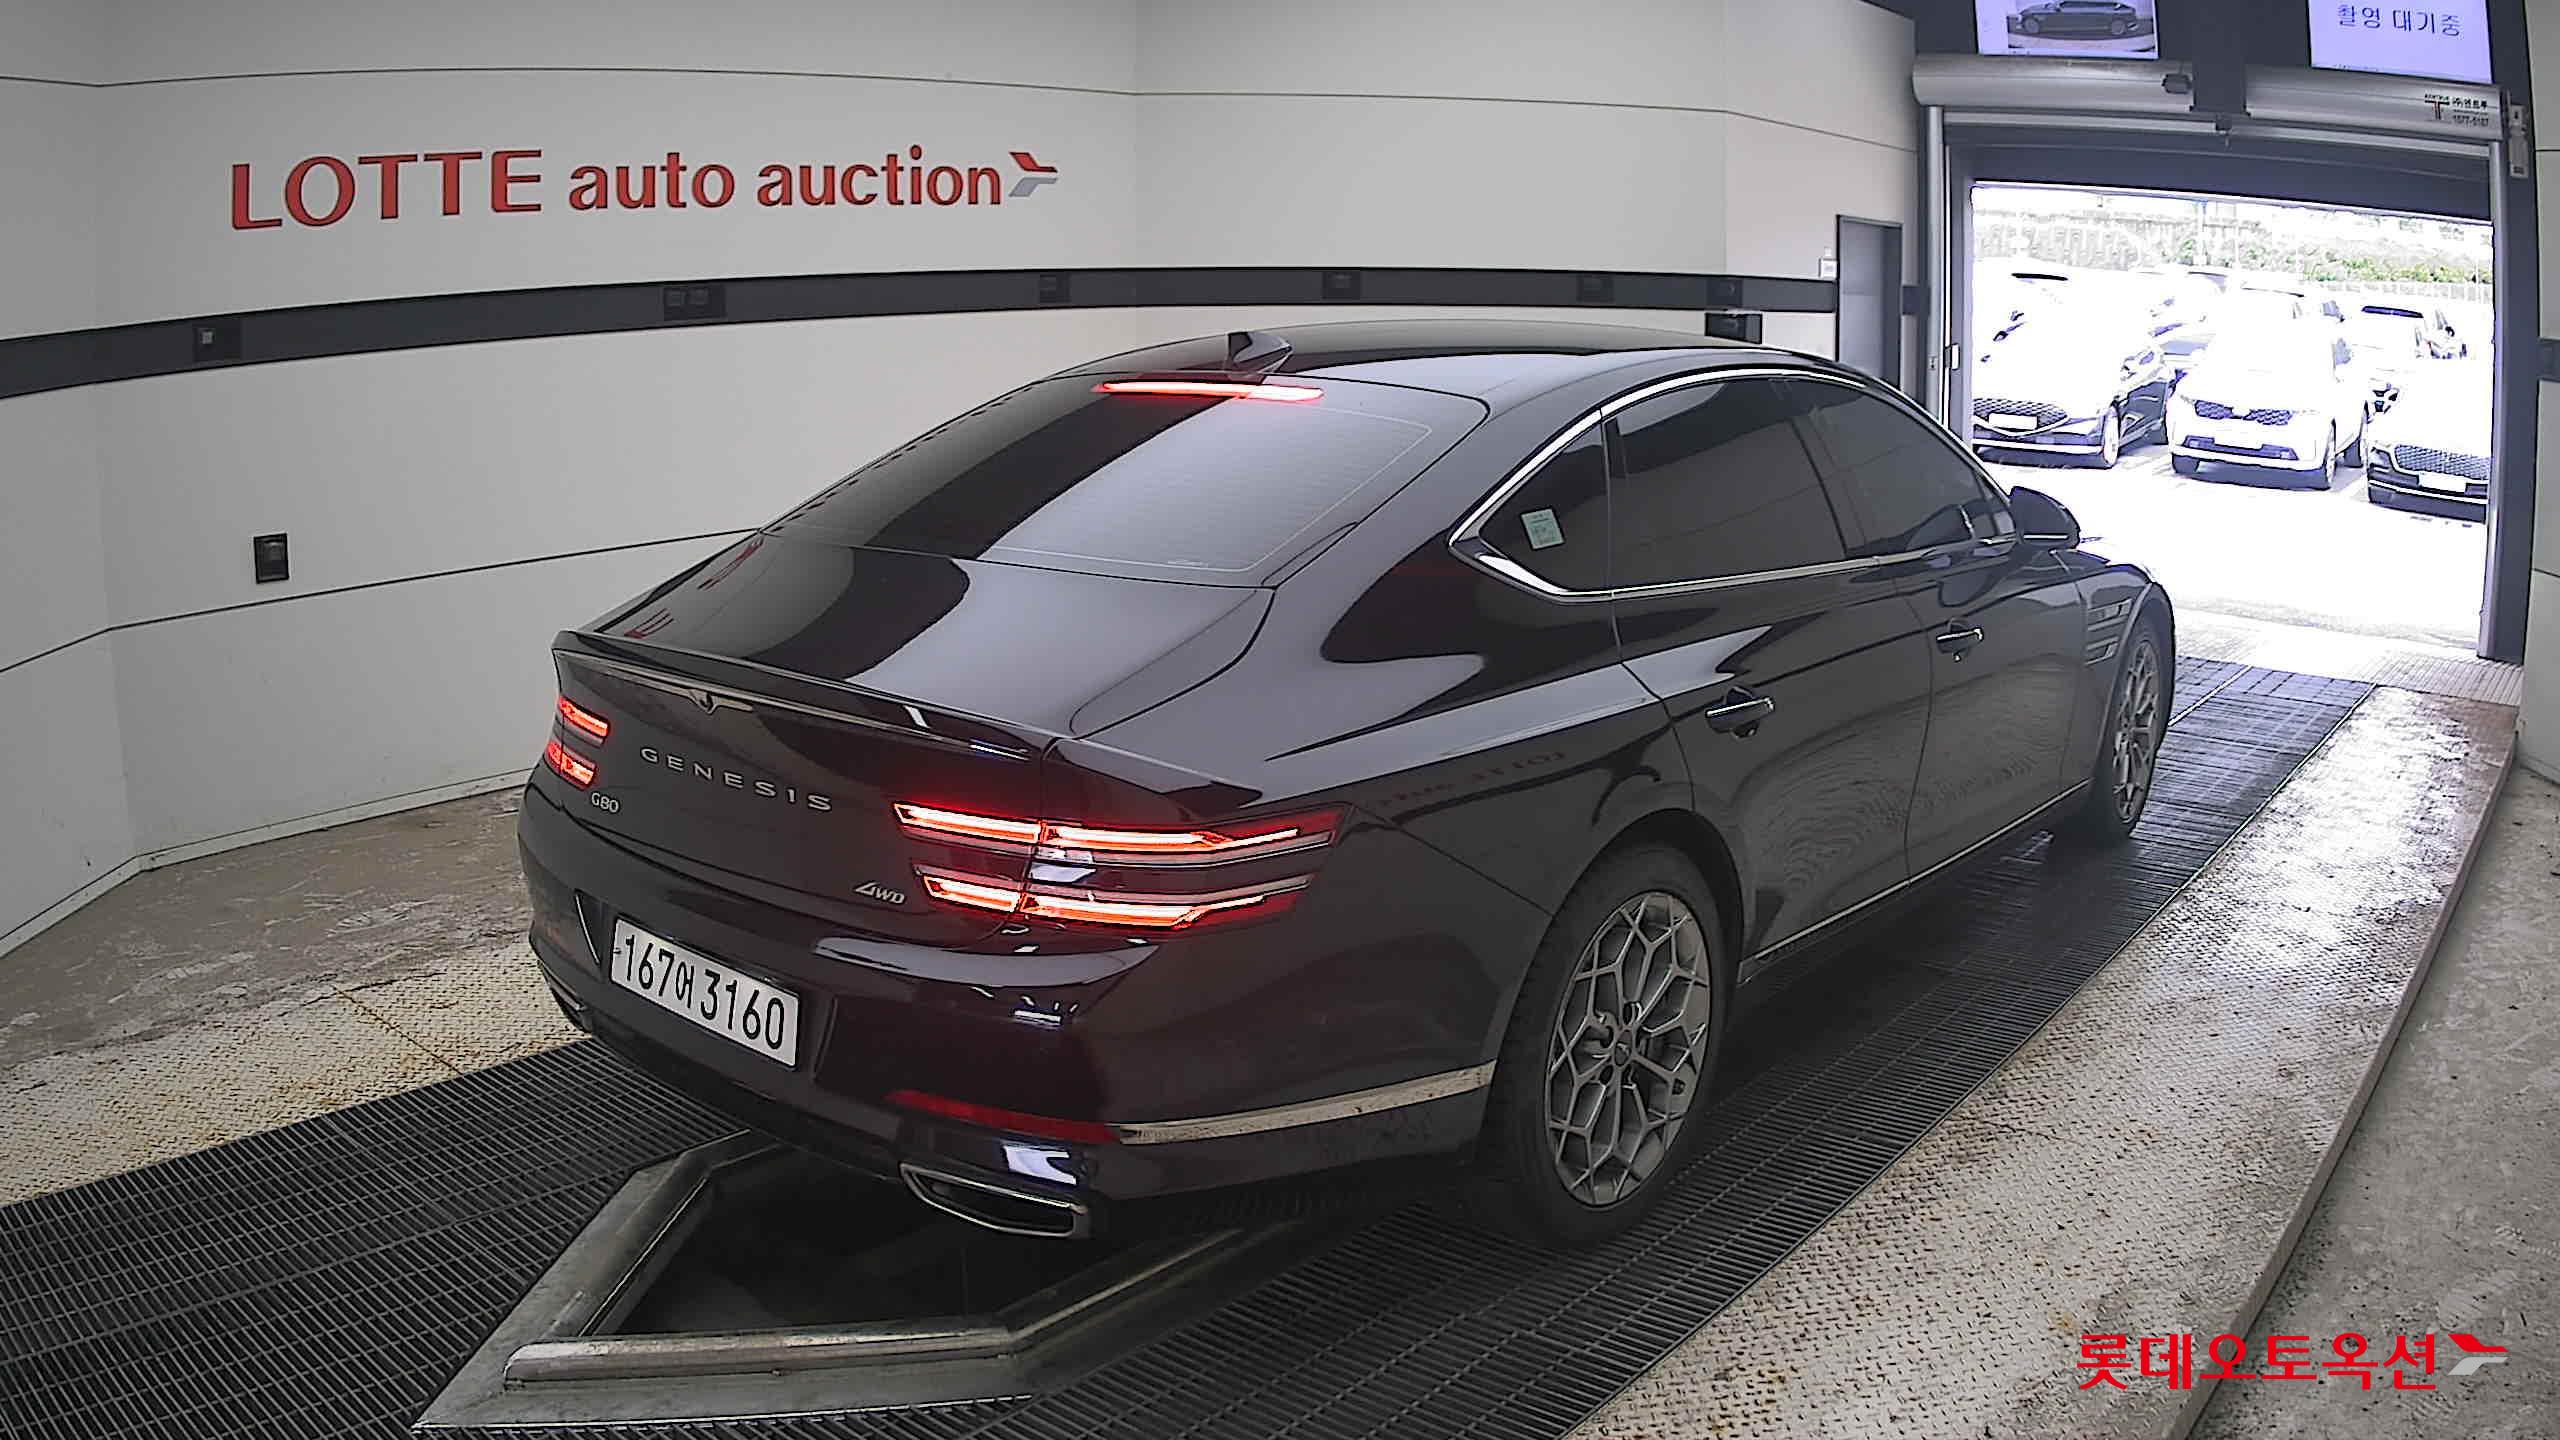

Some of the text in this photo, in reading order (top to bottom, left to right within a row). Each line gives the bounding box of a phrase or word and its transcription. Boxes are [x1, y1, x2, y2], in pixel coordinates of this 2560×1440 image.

[232, 145, 1002, 229] LOTTE auto auction
[640, 747, 832, 812] GENESIS
[591, 792, 619, 813] G80
[855, 882, 905, 904] 4WD
